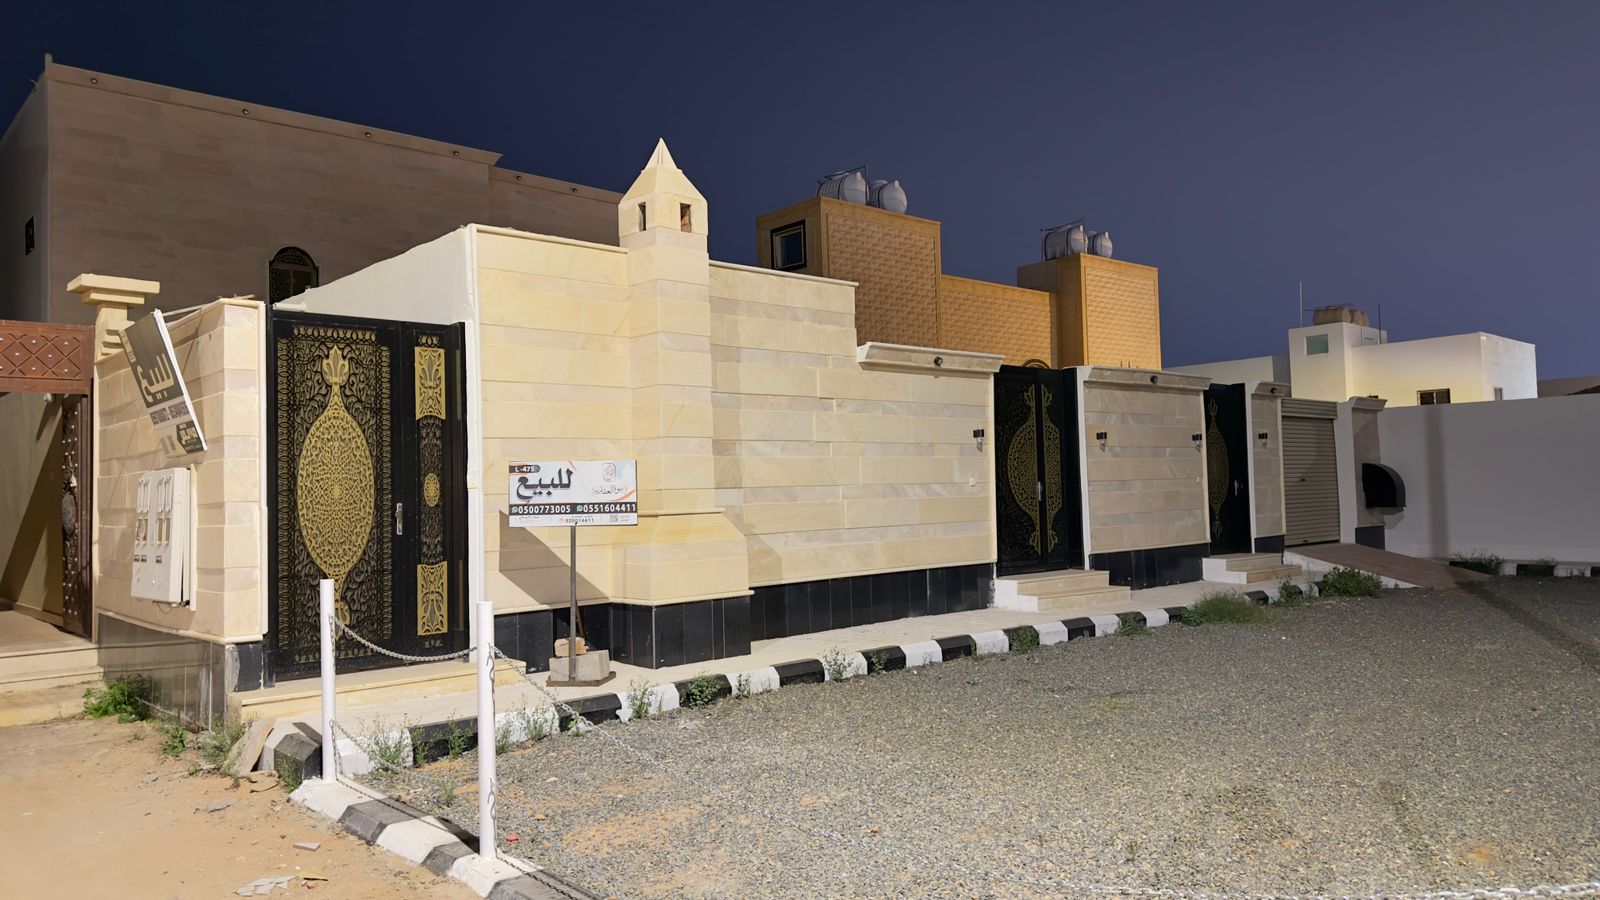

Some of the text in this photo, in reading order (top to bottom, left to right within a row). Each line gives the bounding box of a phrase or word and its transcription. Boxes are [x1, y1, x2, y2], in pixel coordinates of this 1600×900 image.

[137, 353, 174, 403] للبيع
[516, 468, 573, 500] للبيع
[518, 503, 636, 514] 0500773005 0551604411
